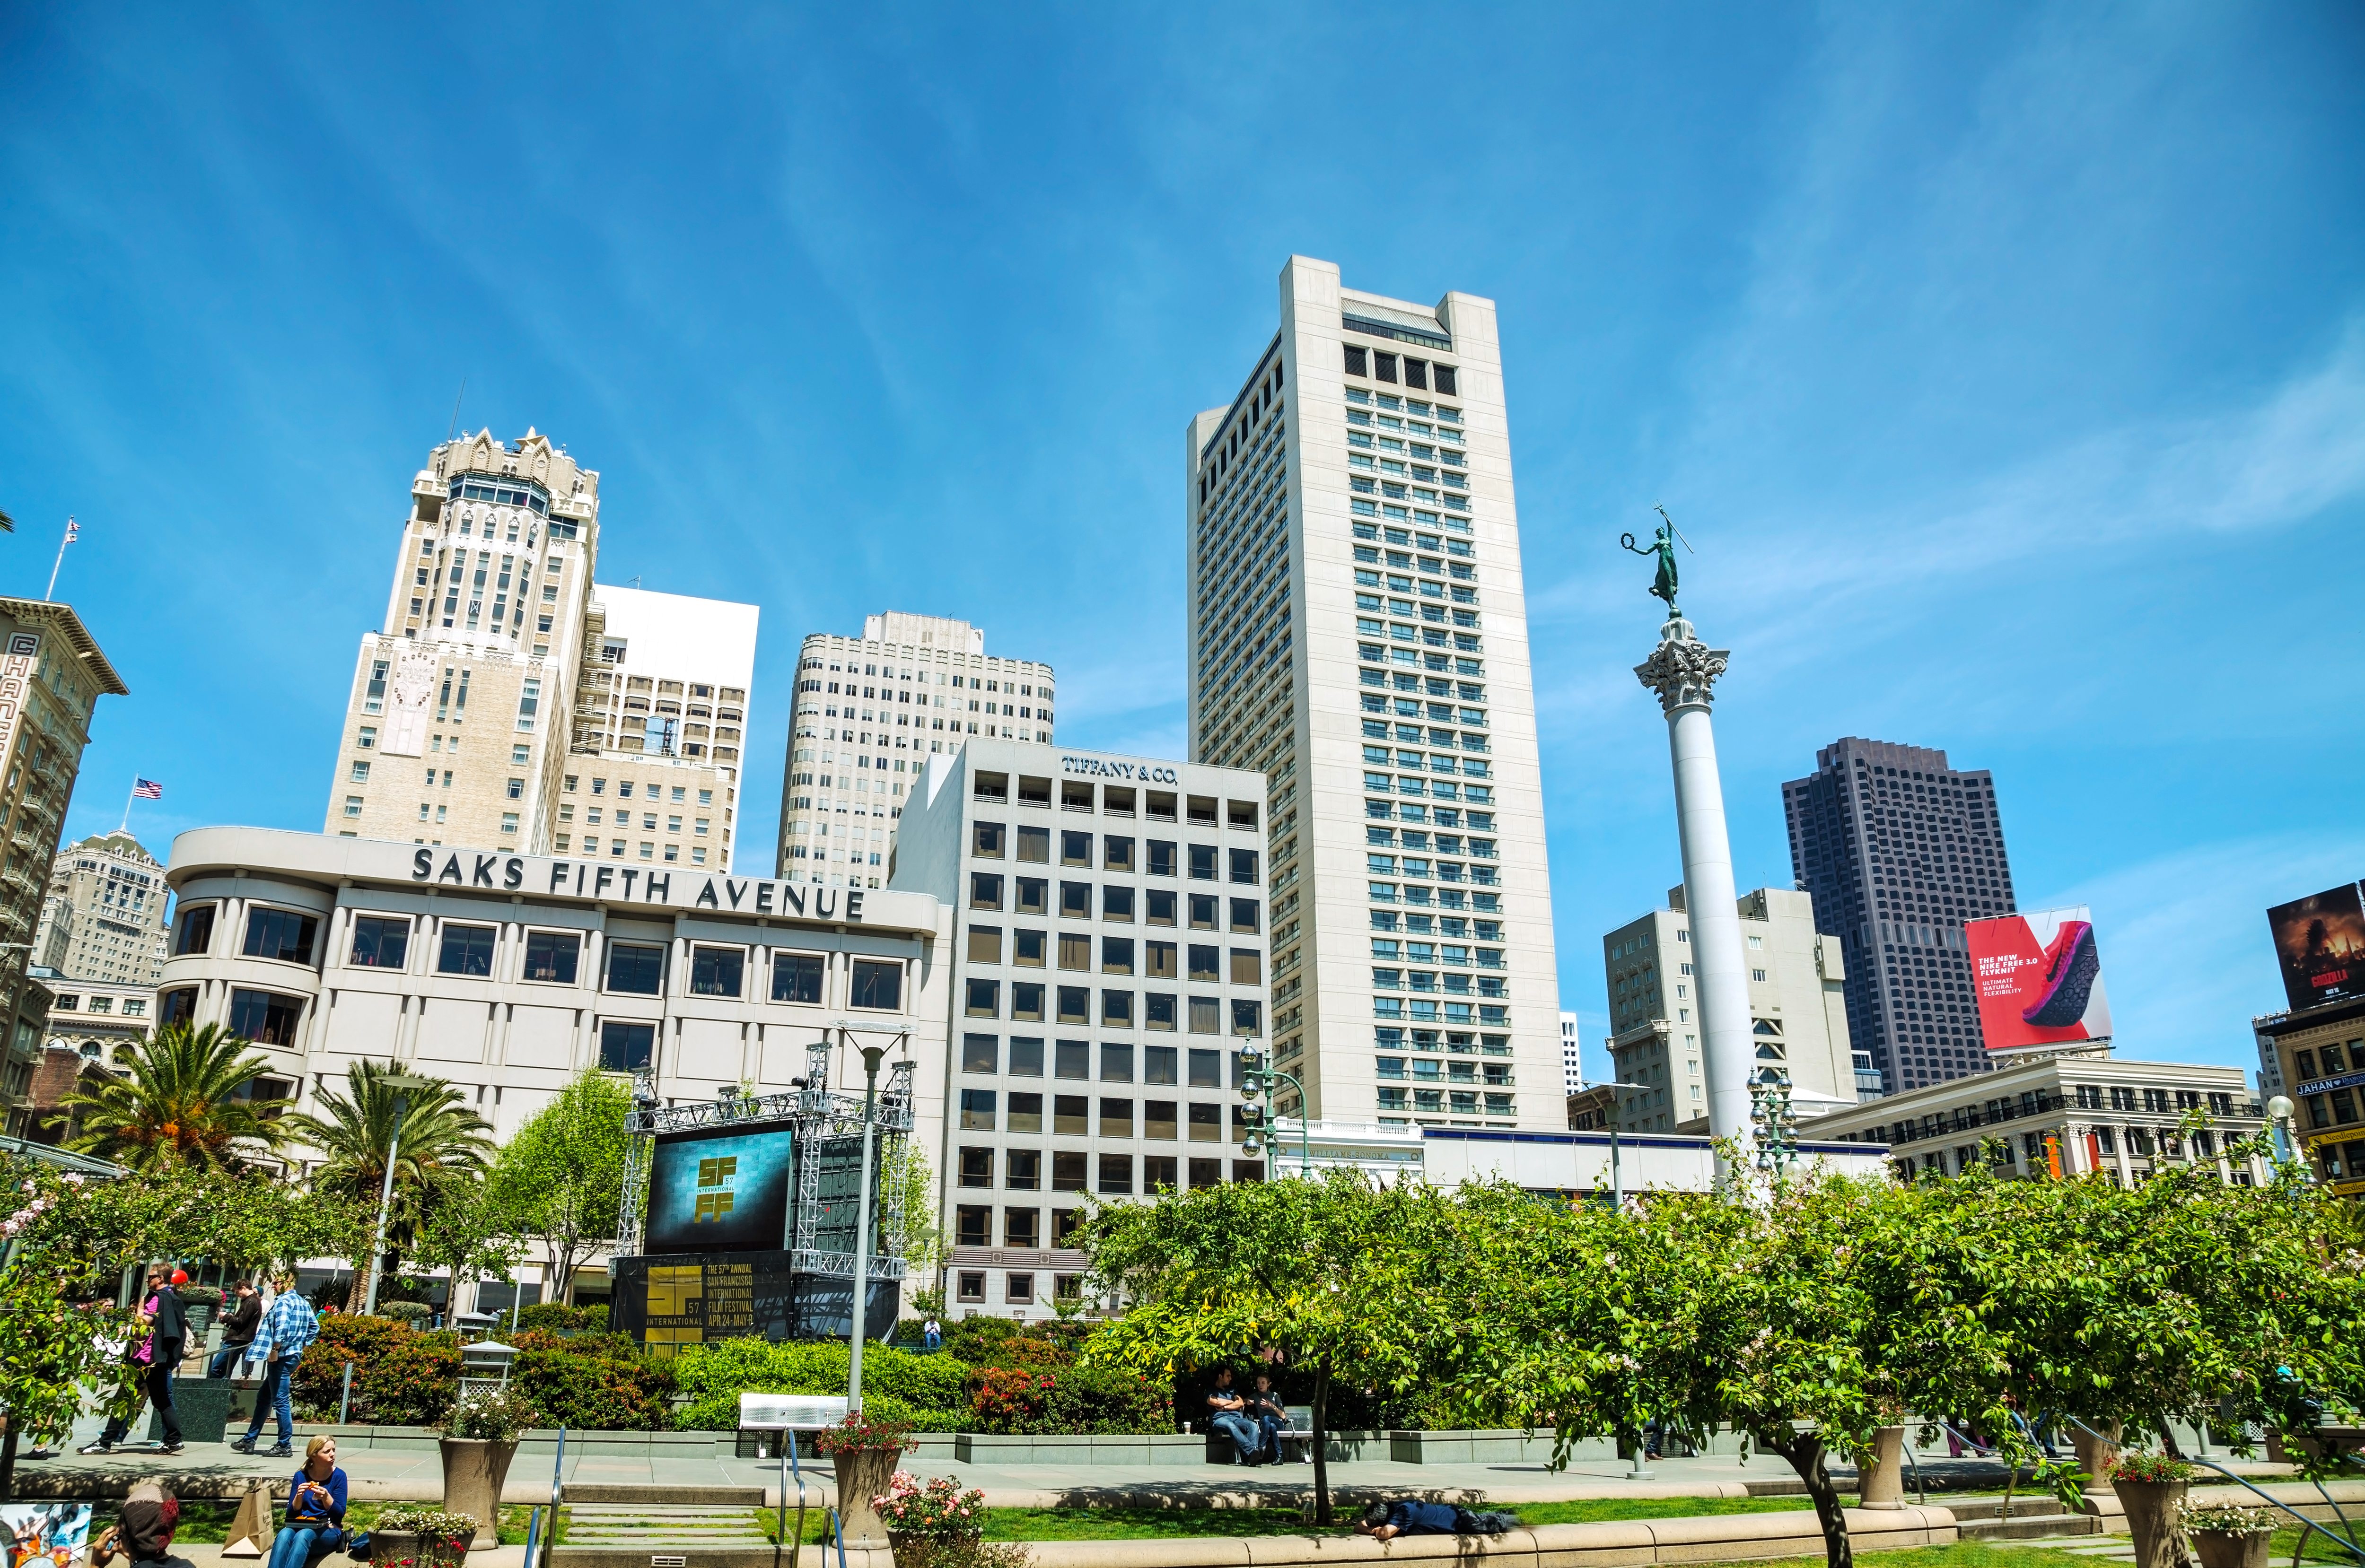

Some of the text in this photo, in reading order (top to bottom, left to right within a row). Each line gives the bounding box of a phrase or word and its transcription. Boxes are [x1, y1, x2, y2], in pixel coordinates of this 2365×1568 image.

[1062, 756, 1135, 778] TIFFANY
[1139, 766, 1150, 780] &
[412, 849, 864, 919] SAKS FIFTH AVENUE
[1980, 962, 2000, 970] NIKE
[2003, 959, 2023, 967] FREE
[1980, 967, 2015, 976] FLYKNIT
[1982, 978, 2014, 986] ULTIMATE
[1984, 988, 2022, 996] FLEXIBILITY
[2298, 1080, 2333, 1094] JAHAN
[1309, 1150, 1390, 1159] WILLIAMS-SONOMA
[708, 1263, 752, 1274] THE 57TH ANNUAL
[708, 1275, 753, 1287] SAN FRANCISCO
[708, 1288, 753, 1299] INTERNATIONAL
[689, 1303, 699, 1314] 57
[709, 1301, 753, 1313] FILM FESTIVAL
[647, 1317, 702, 1325] INTERNATIONAL
[709, 1315, 721, 1326] APR
